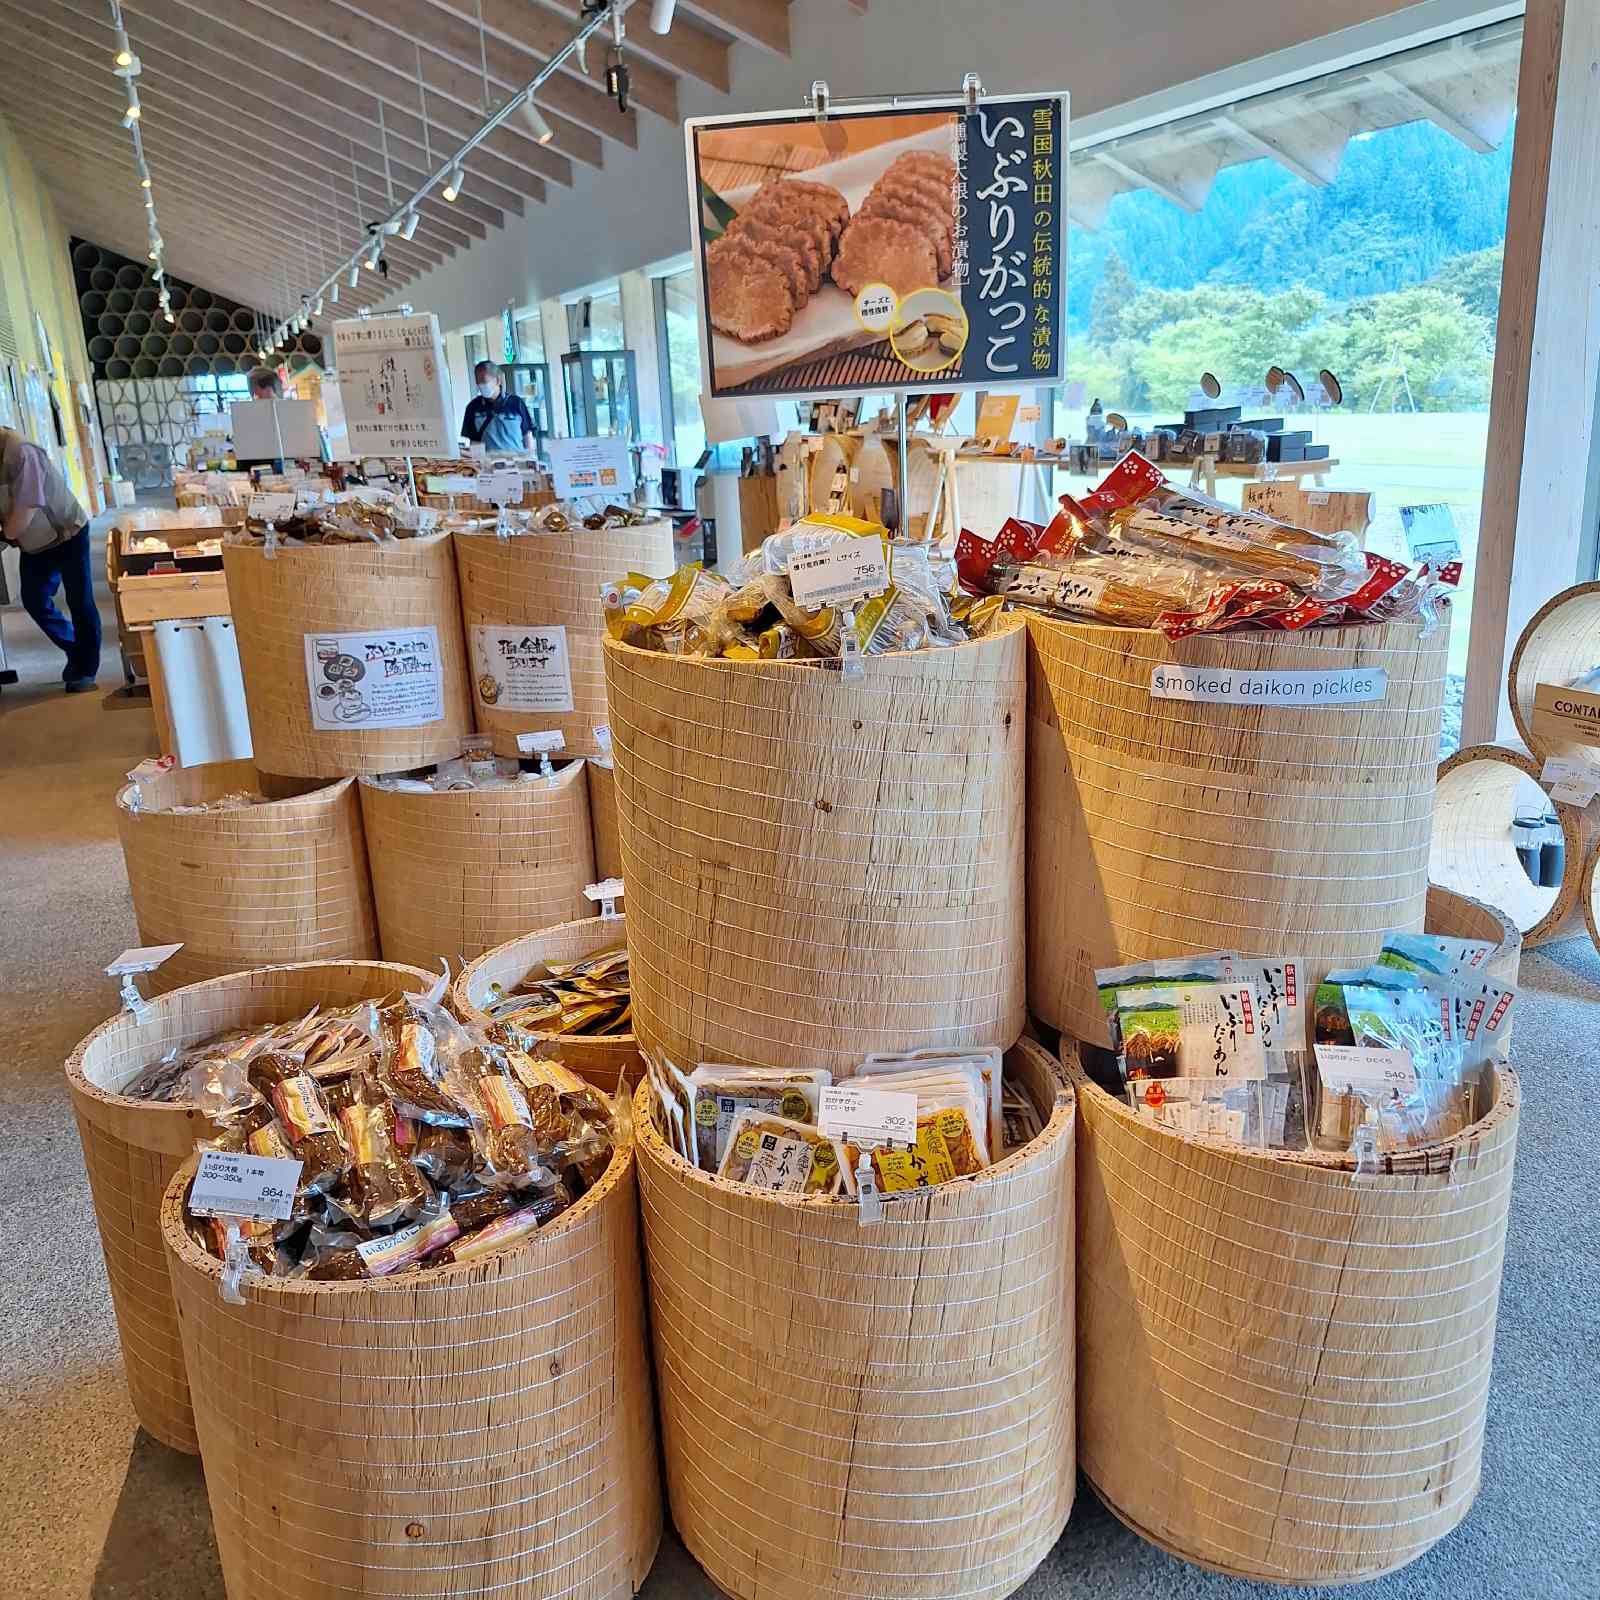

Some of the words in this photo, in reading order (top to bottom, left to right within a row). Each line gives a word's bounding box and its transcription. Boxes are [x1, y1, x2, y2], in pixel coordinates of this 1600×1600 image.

[977, 111, 1028, 374] いぶりがっこ
[1032, 108, 1053, 370] 雪国秋田の伝統的な漬物
[853, 564, 876, 575] 756
[1155, 675, 1231, 694] smoked
[1239, 678, 1305, 696] daikon
[1312, 675, 1373, 698] pickles
[1219, 994, 1243, 1052] いぶり
[1213, 1023, 1228, 1077] たくあん
[1384, 1071, 1406, 1080] 540
[884, 1116, 906, 1126] 302
[261, 1186, 283, 1198] 864
